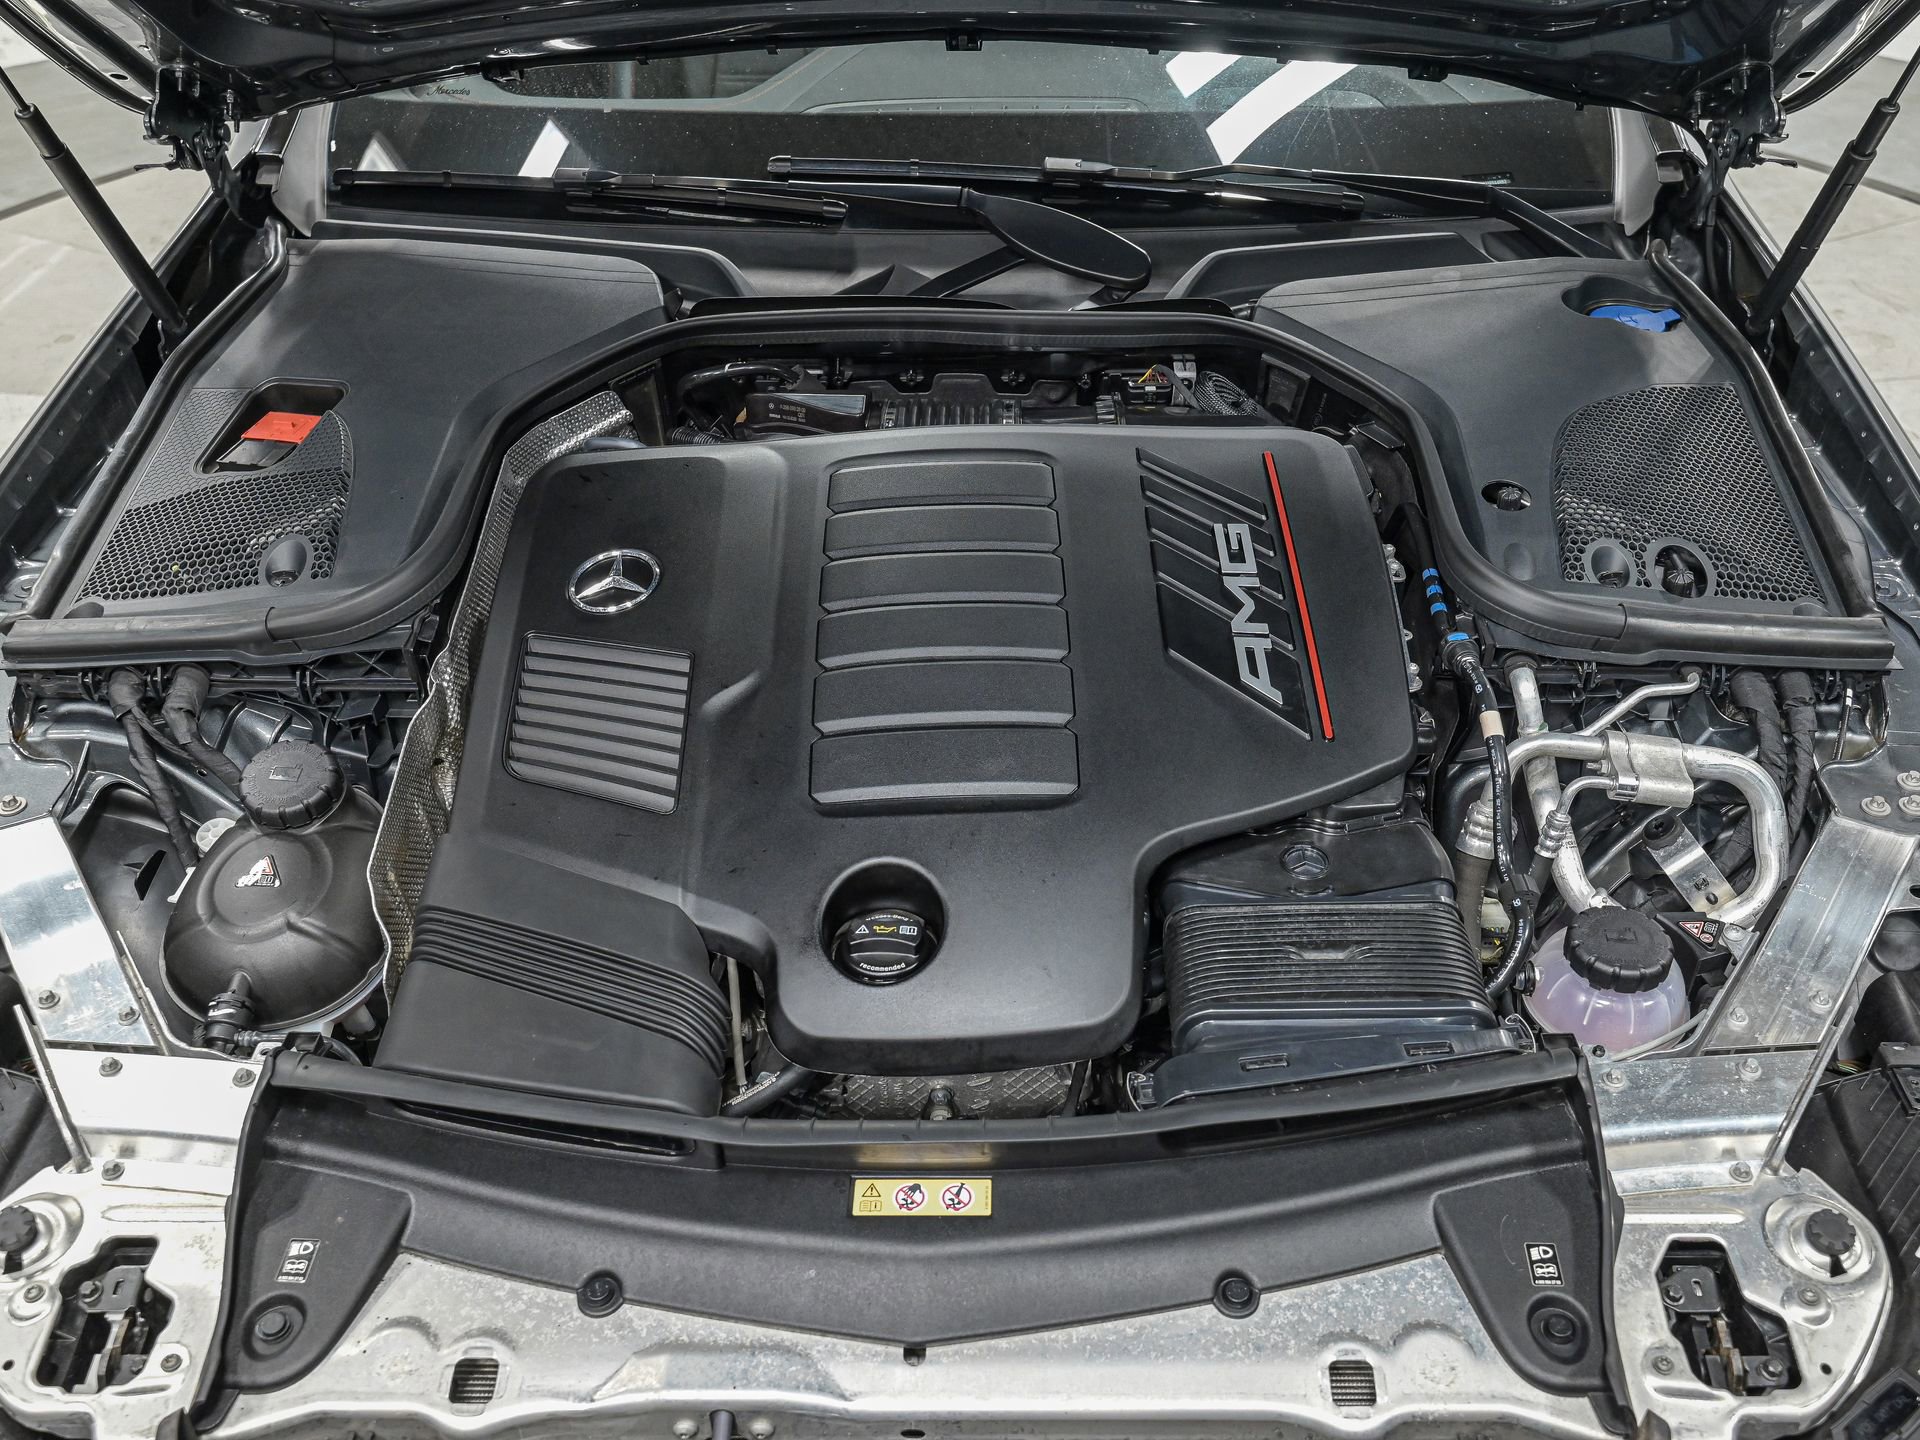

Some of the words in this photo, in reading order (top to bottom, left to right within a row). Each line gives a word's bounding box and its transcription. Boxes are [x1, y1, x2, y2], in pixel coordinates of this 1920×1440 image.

[426, 84, 471, 96] Mercedes
[1213, 523, 1283, 706] AMG
[859, 962, 906, 972] recommended
